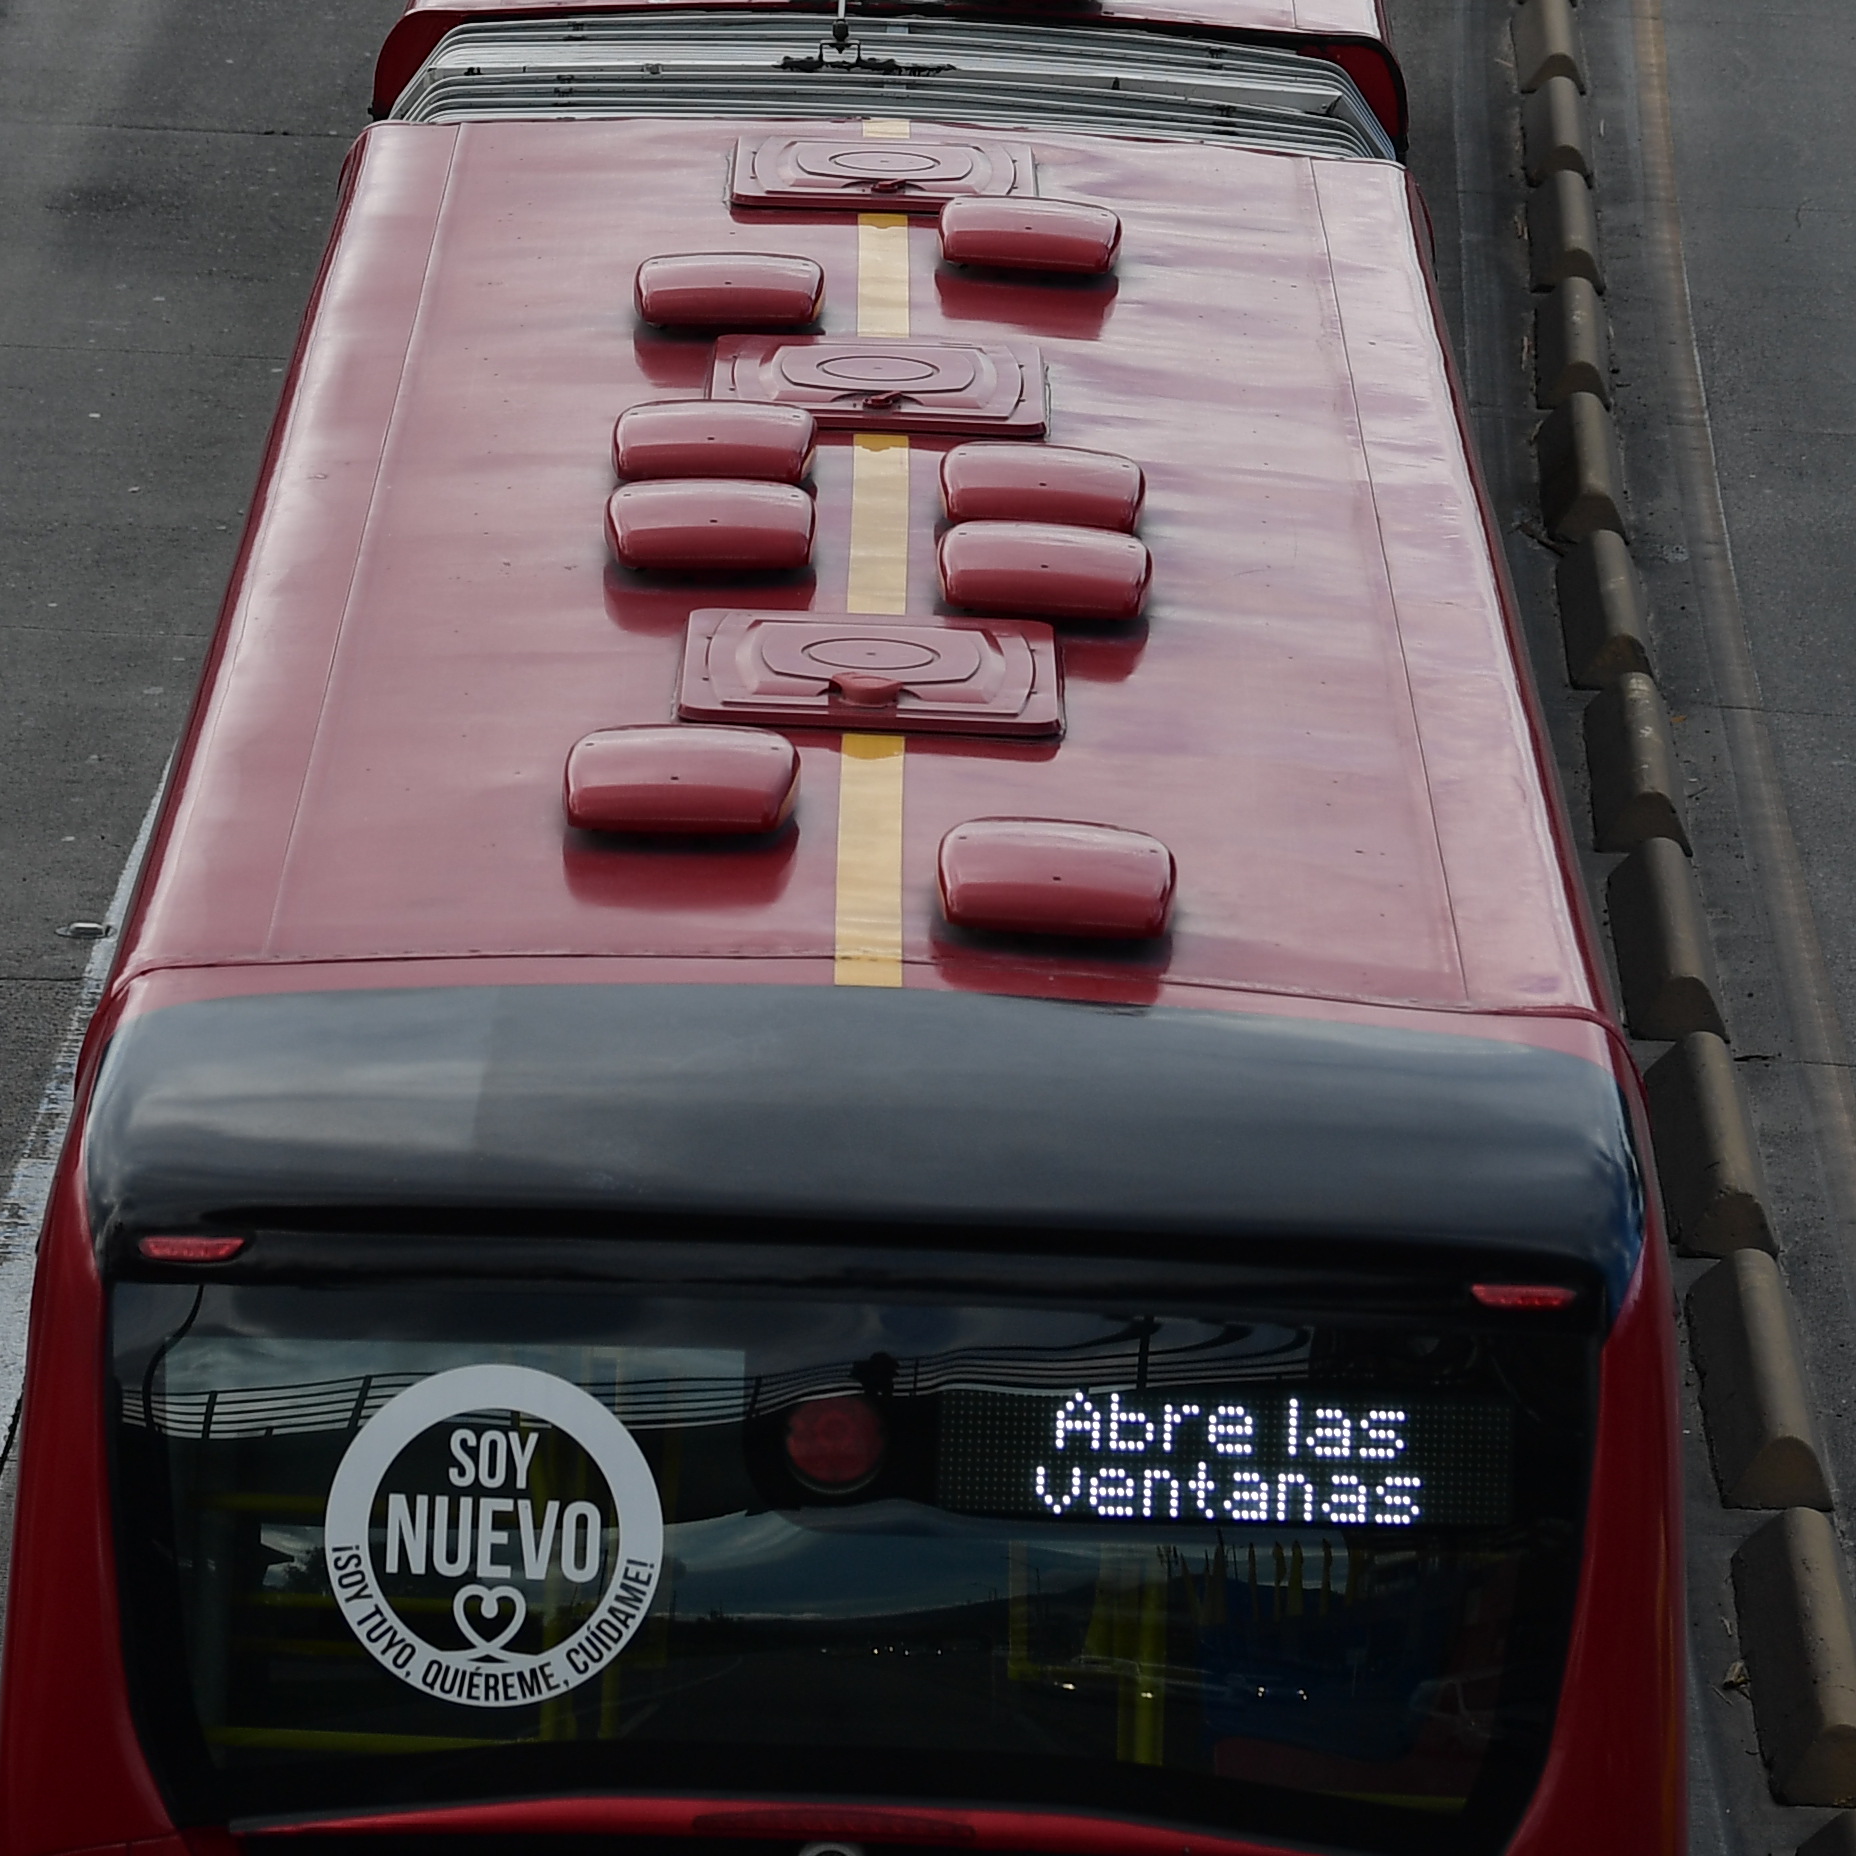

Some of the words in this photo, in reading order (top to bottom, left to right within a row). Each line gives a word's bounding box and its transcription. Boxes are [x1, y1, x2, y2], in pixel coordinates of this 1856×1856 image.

[449, 1428, 540, 1490] SOY
[1052, 1391, 1254, 1456] Abre
[1289, 1397, 1408, 1459] las
[1034, 1460, 1422, 1525] ventanas
[384, 1493, 602, 1584] NUEVO
[330, 1543, 372, 1607] ¡SOY
[355, 1601, 418, 1678] TUYO,
[421, 1659, 573, 1703] QUIÉREME,
[566, 1555, 657, 1677] CUÍDAME!
